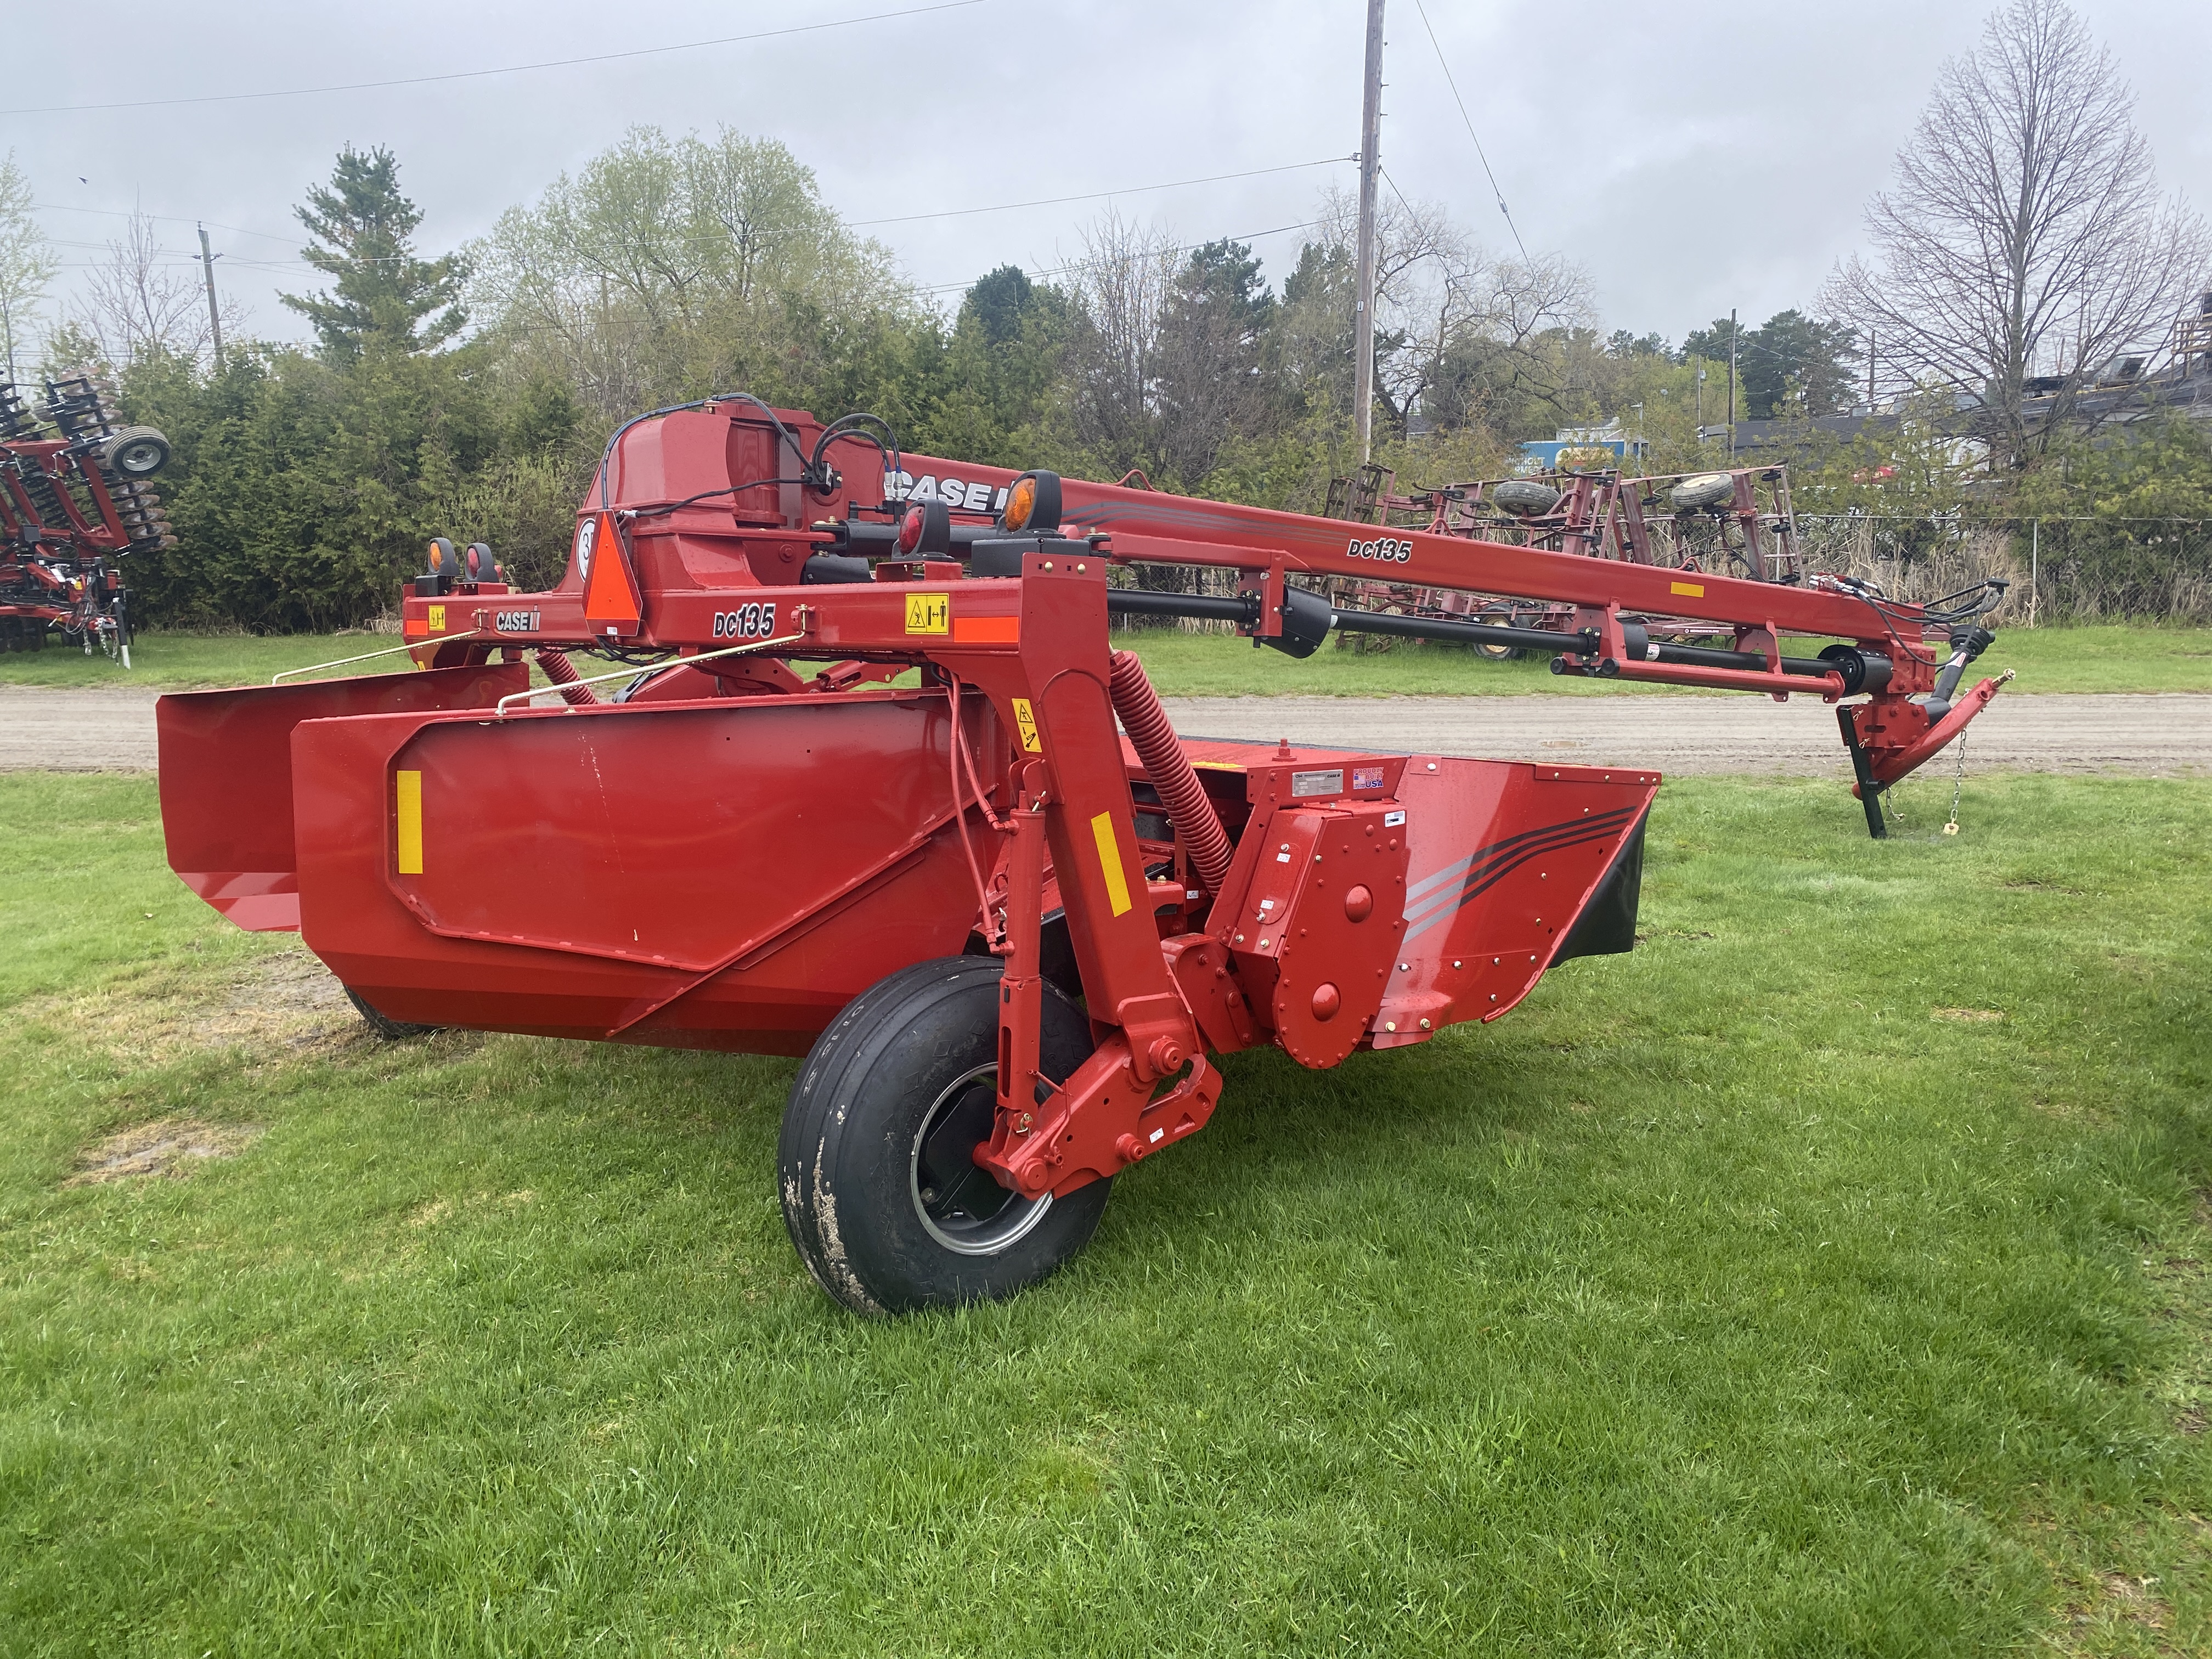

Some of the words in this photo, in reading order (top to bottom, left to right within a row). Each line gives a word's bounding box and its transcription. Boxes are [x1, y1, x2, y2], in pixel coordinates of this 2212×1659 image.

[883, 470, 992, 511] CASE
[583, 532, 593, 560] 3
[1346, 537, 1413, 564] DC135
[496, 611, 528, 631] CASE
[713, 602, 776, 639] DC135
